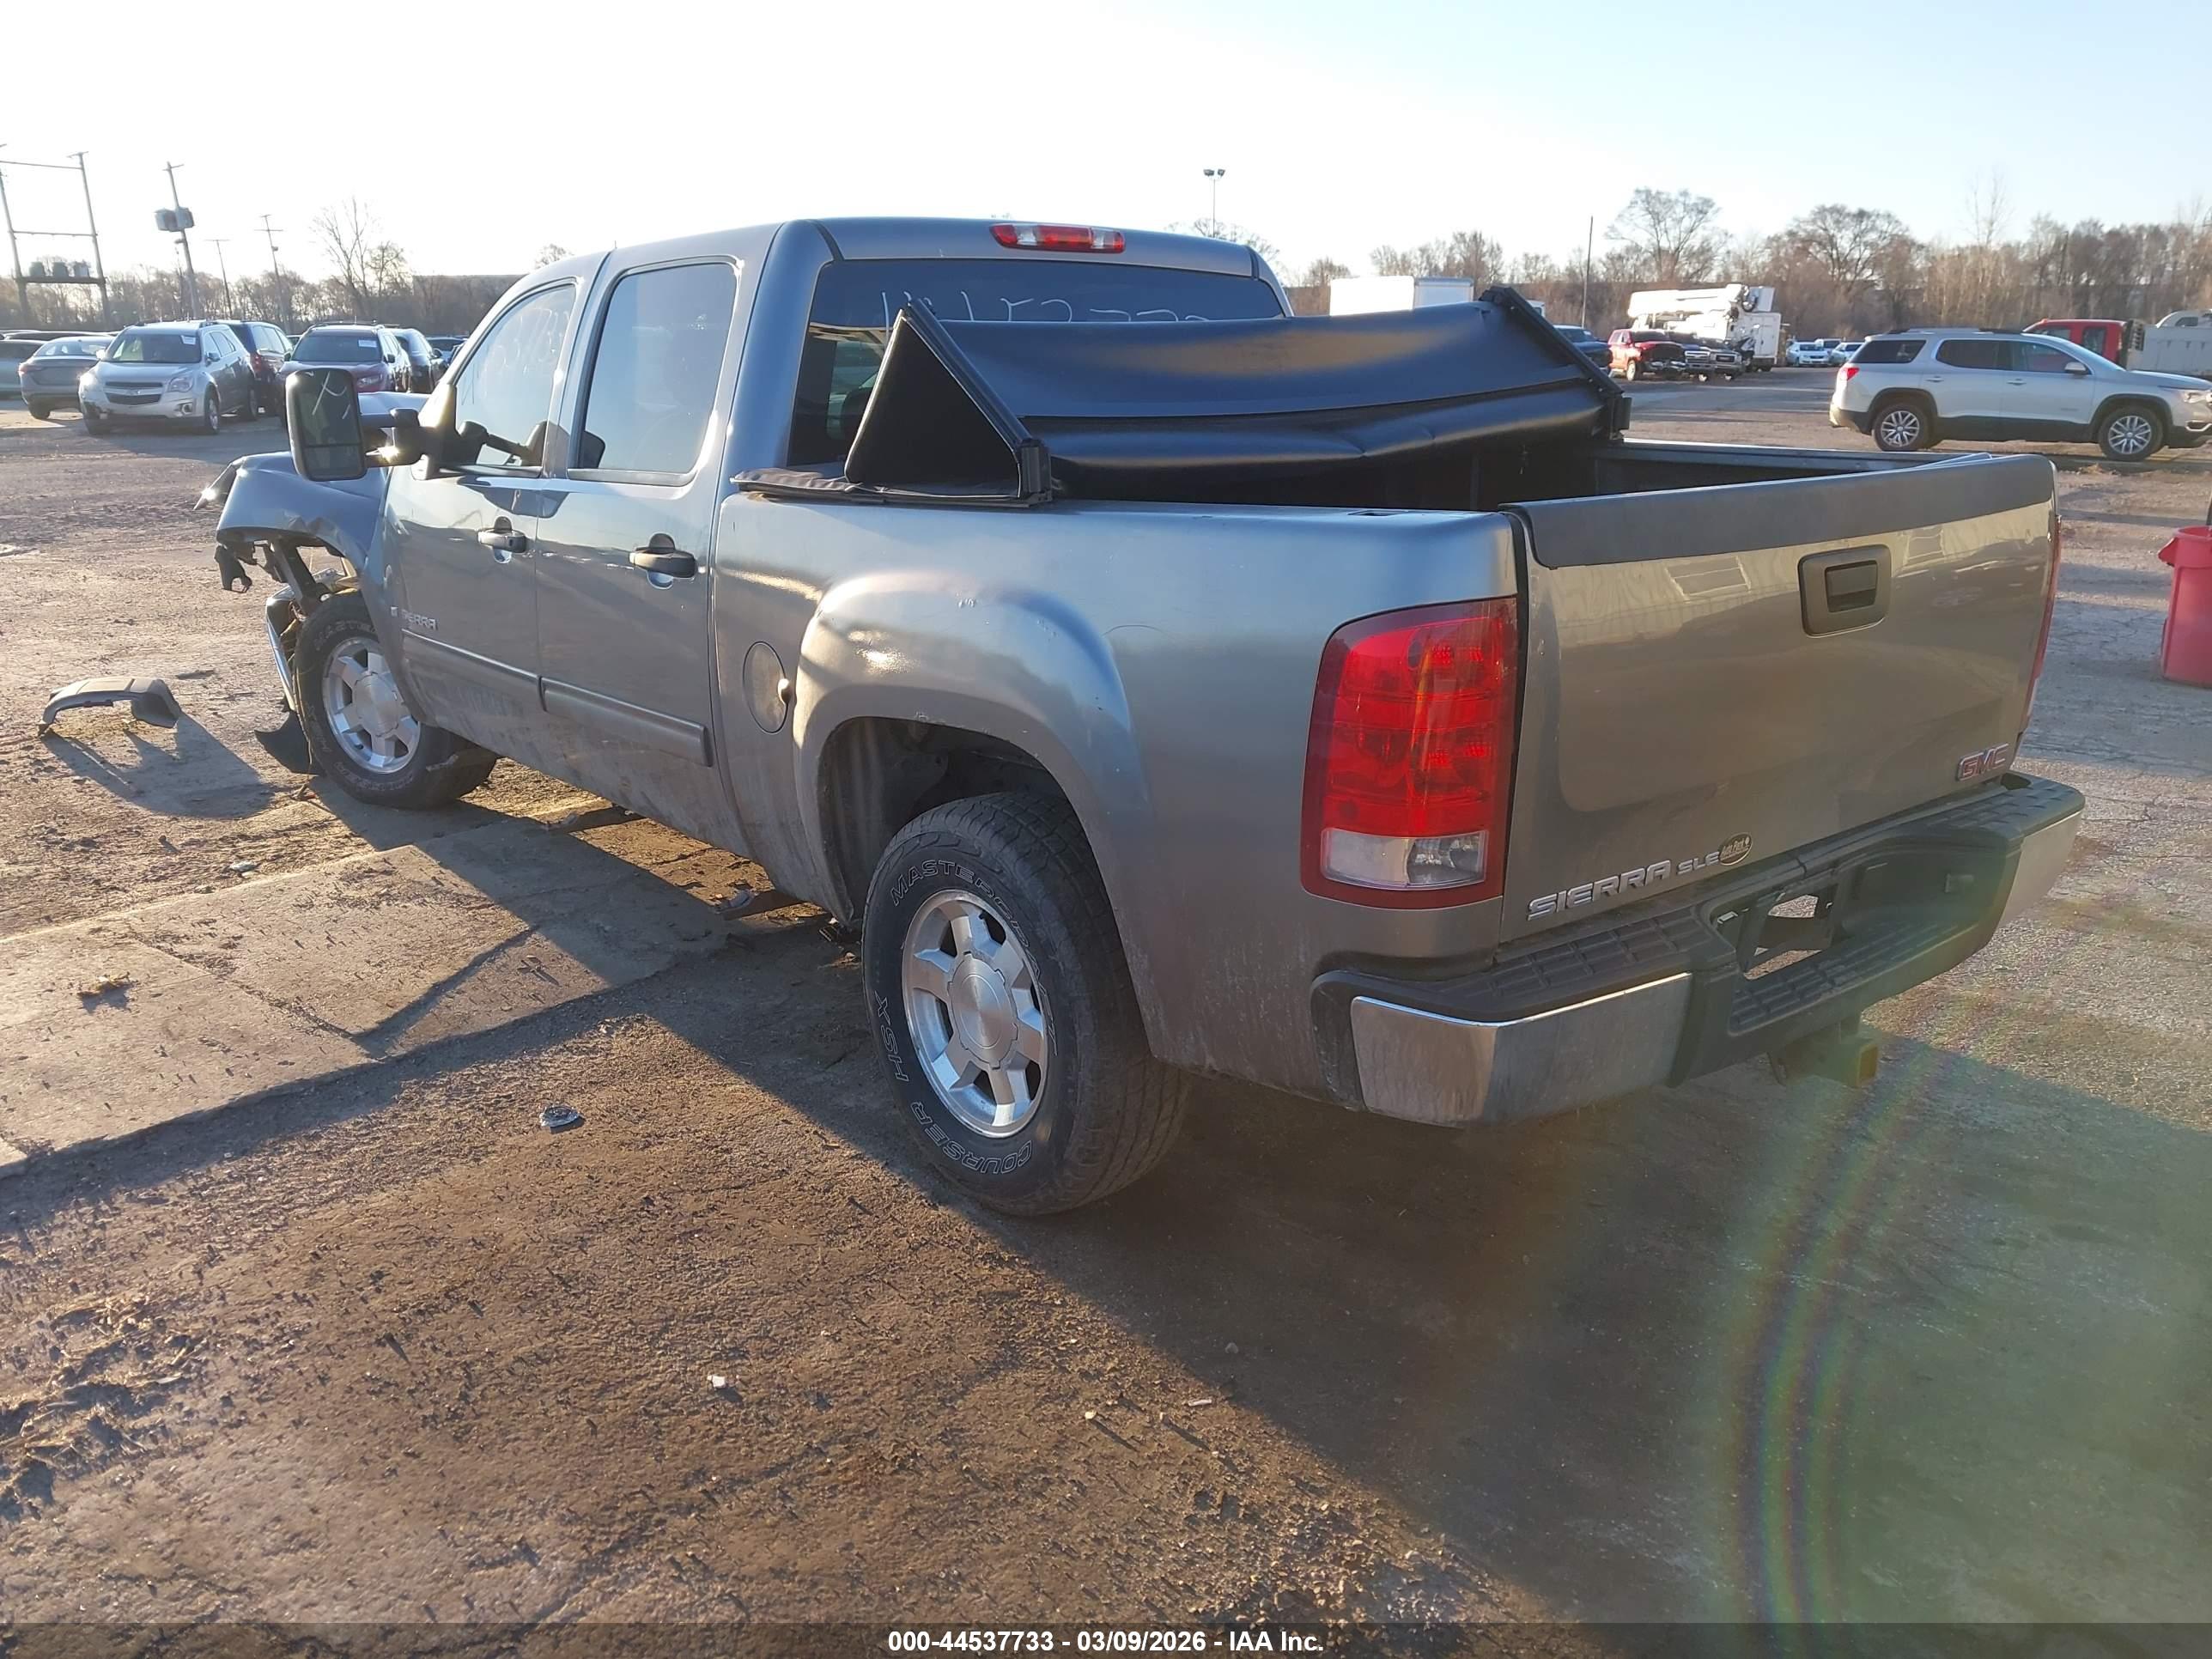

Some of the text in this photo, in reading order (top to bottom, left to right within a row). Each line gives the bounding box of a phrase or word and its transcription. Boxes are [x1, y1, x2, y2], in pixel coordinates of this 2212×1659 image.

[1957, 743, 2009, 781] GMC
[1527, 851, 1720, 921] SIERRA SLE
[875, 990, 1032, 1175] COURSER HSX
